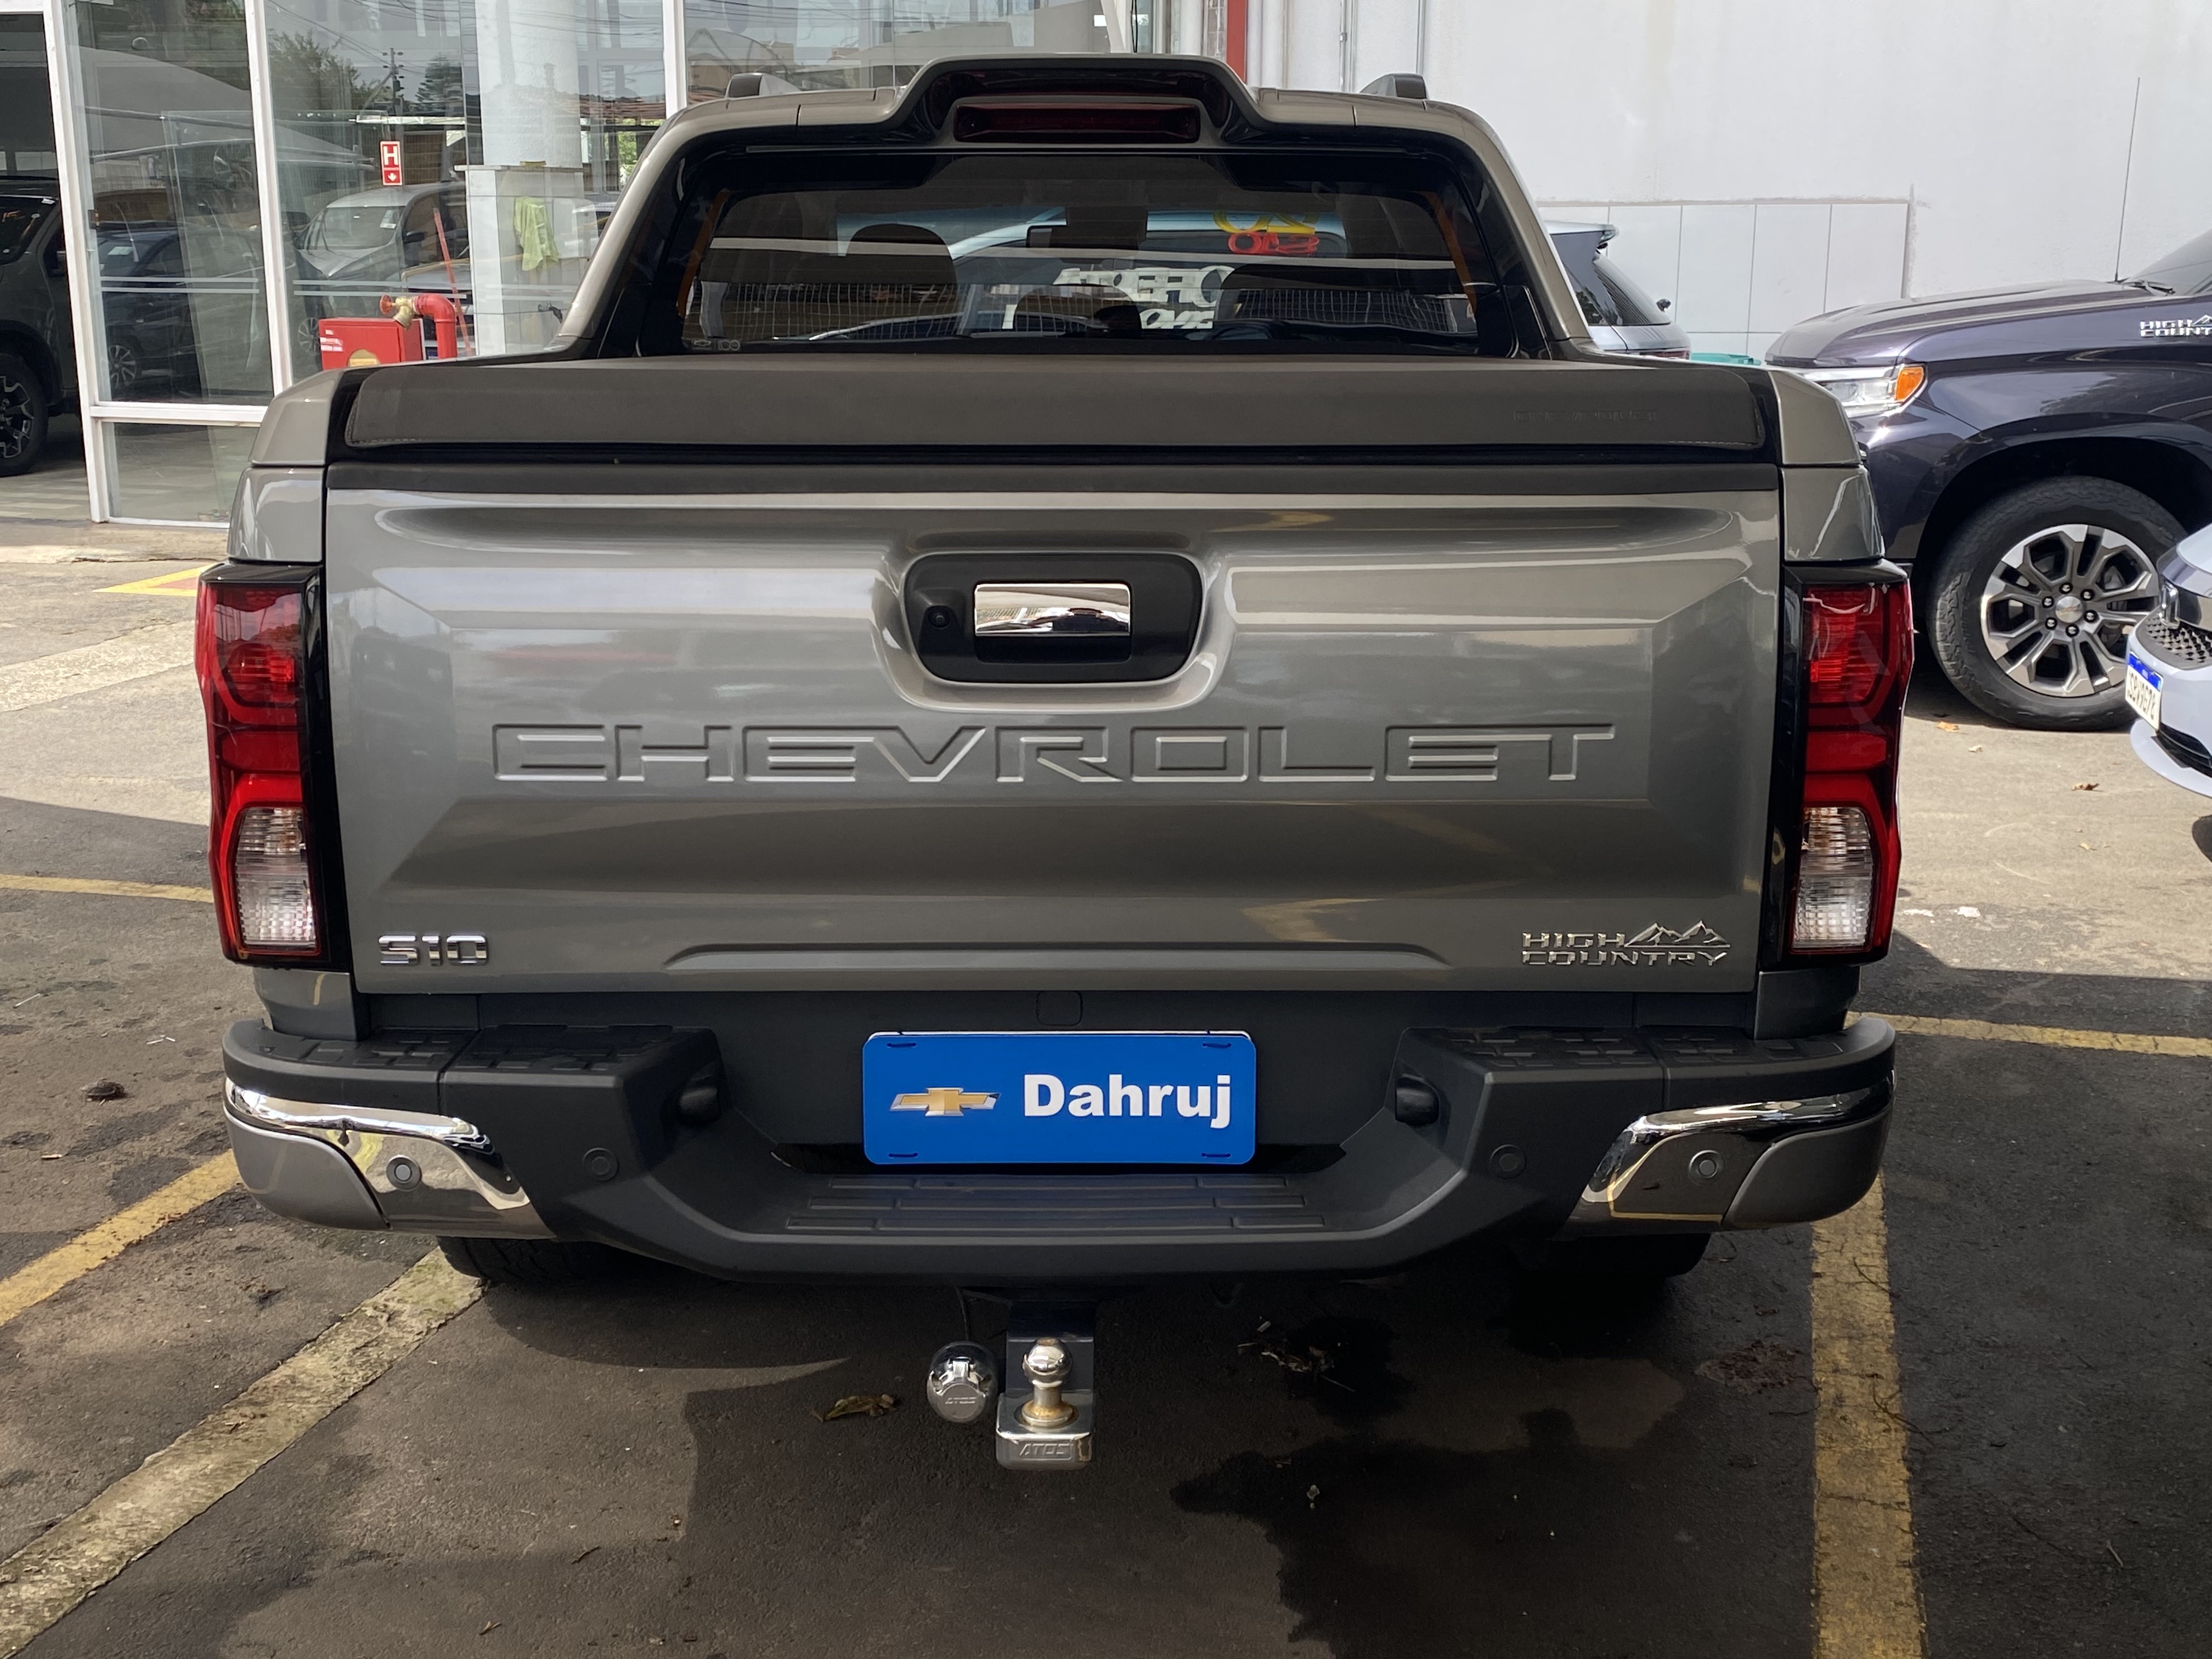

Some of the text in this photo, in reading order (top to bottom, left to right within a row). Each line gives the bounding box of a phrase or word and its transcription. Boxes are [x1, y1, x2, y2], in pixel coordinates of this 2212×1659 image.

[383, 145, 399, 166] H
[2140, 319, 2193, 330] HIGH
[493, 723, 1615, 783] CHEVROLET
[379, 934, 487, 966] S10
[1522, 932, 1626, 947] HIGH
[1522, 950, 1728, 966] COUNTRY
[1024, 1074, 1231, 1130] Dahruj
